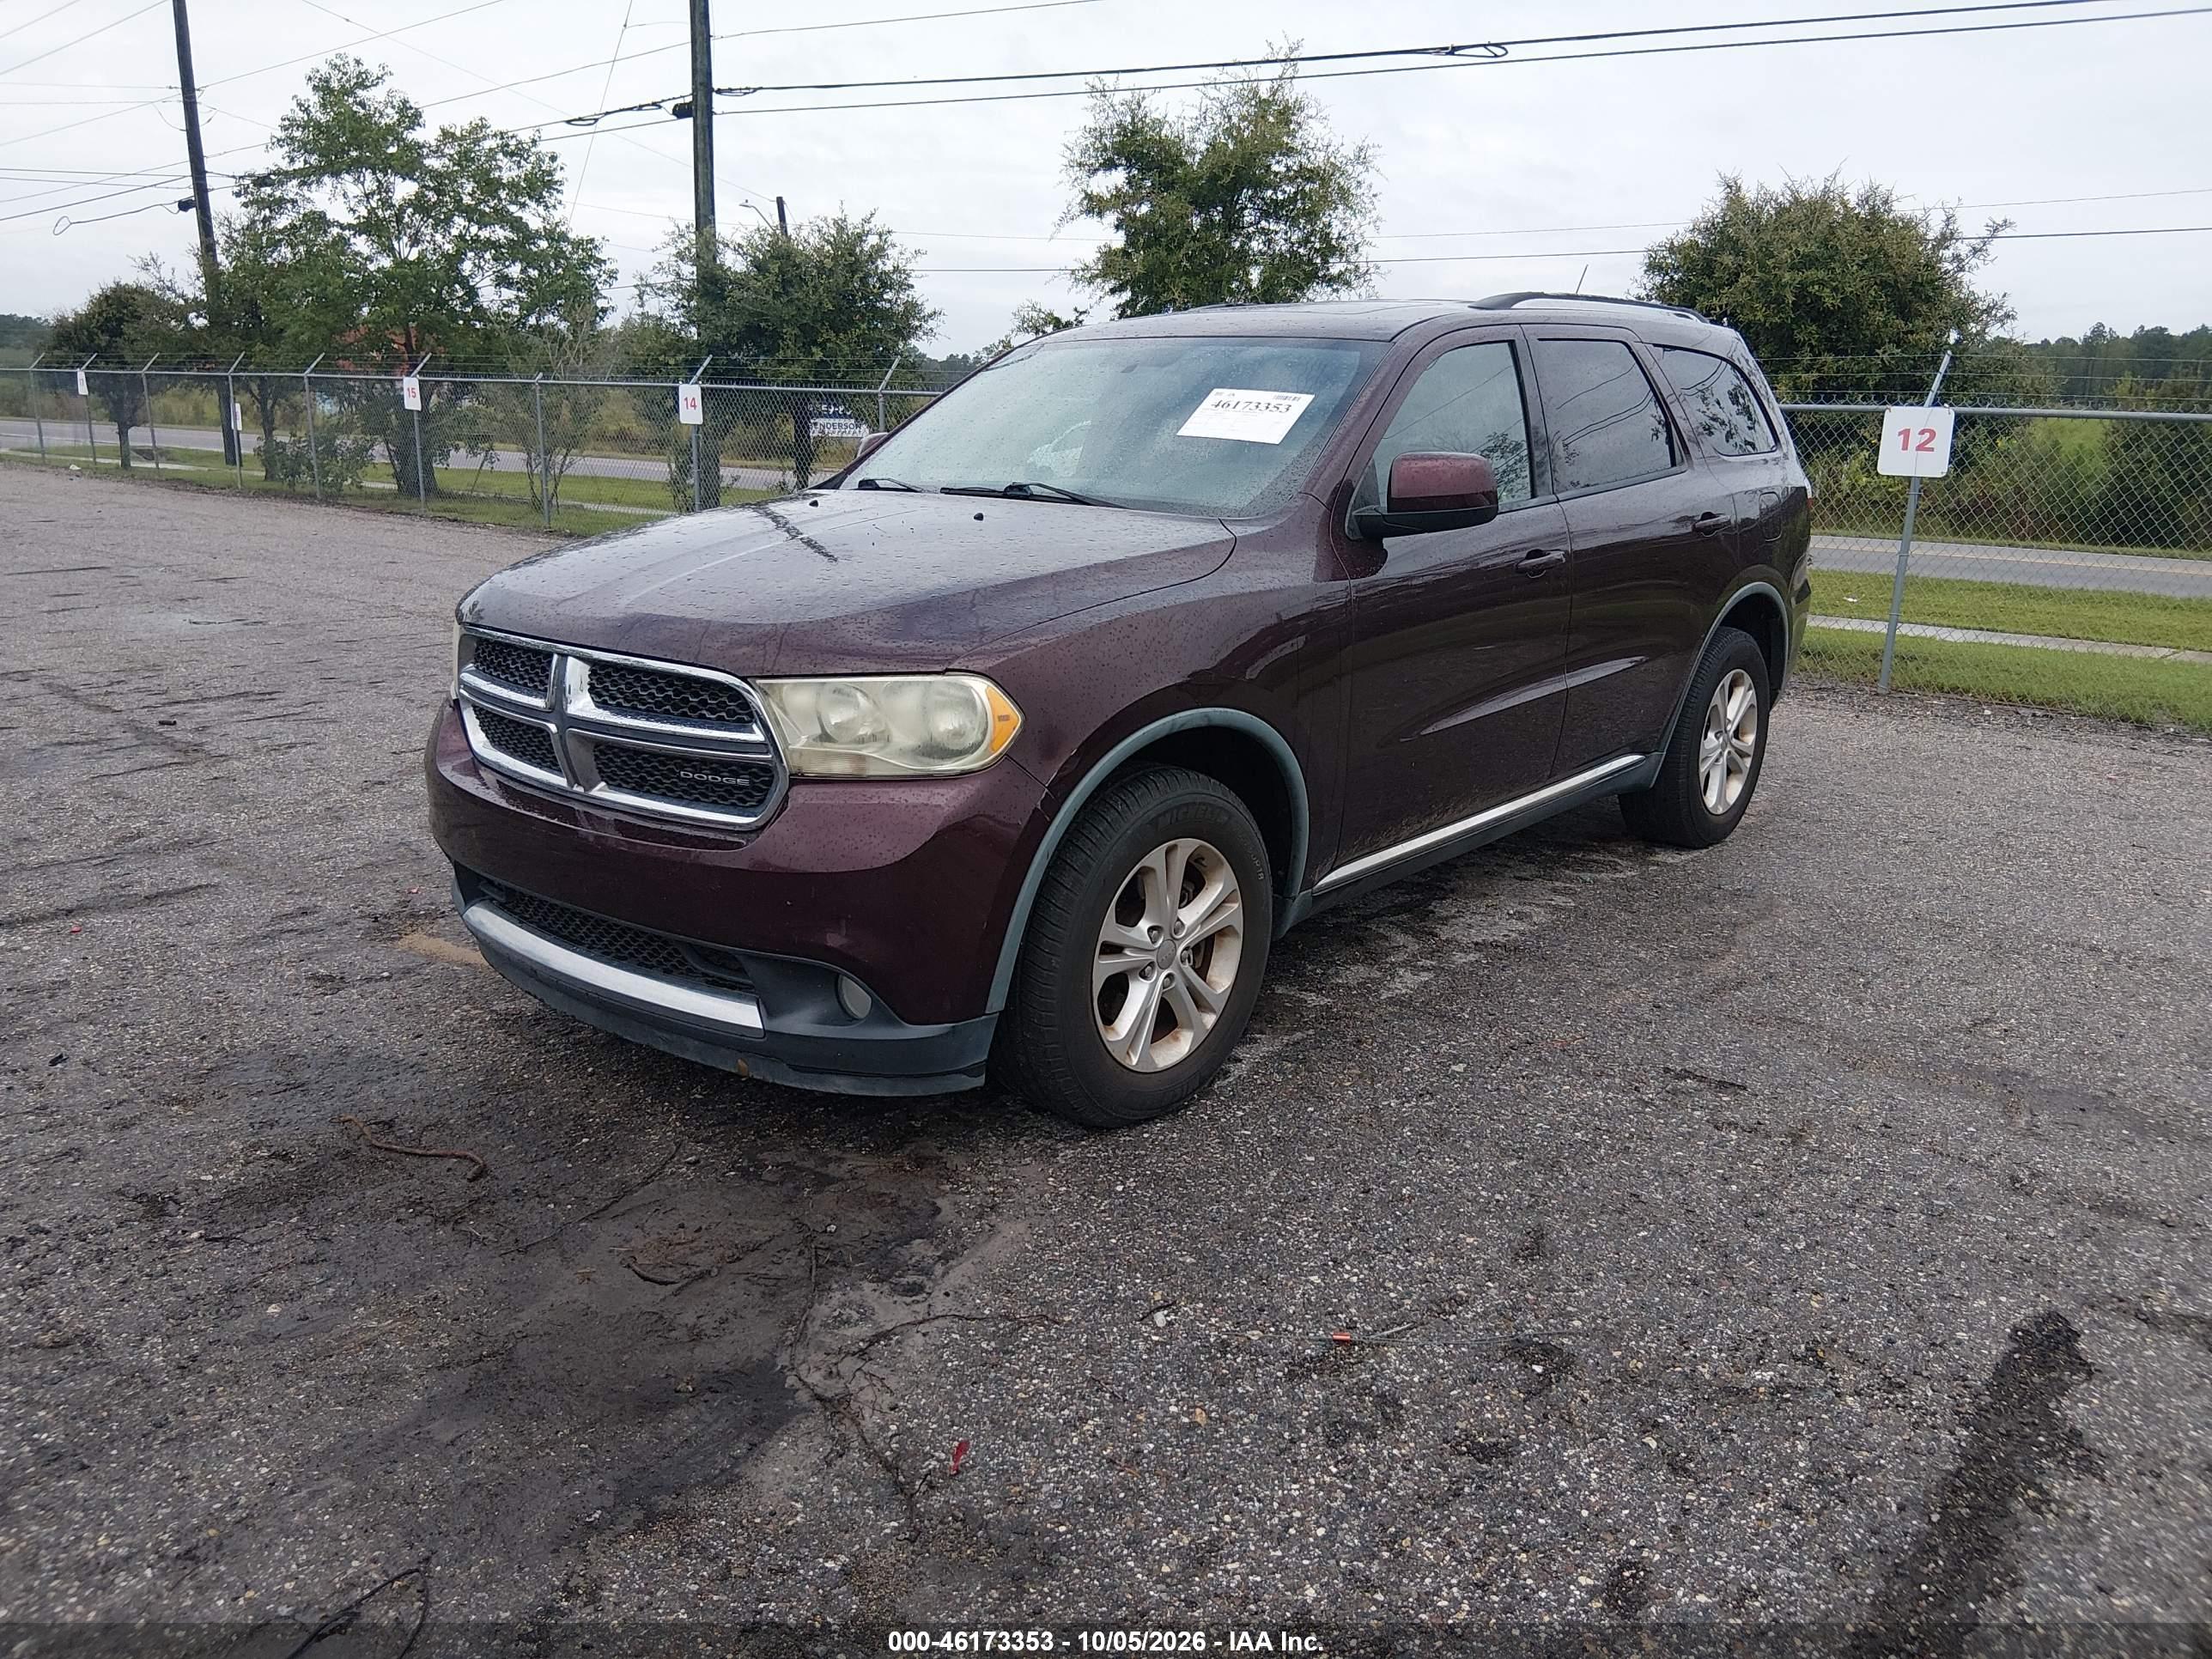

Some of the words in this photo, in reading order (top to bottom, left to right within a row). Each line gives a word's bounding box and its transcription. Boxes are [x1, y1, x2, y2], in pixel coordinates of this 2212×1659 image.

[407, 386, 416, 399] 15
[684, 396, 697, 410] 14
[1211, 399, 1292, 413] 46173353
[1897, 428, 1937, 453] 12
[679, 771, 750, 786] DODGE
